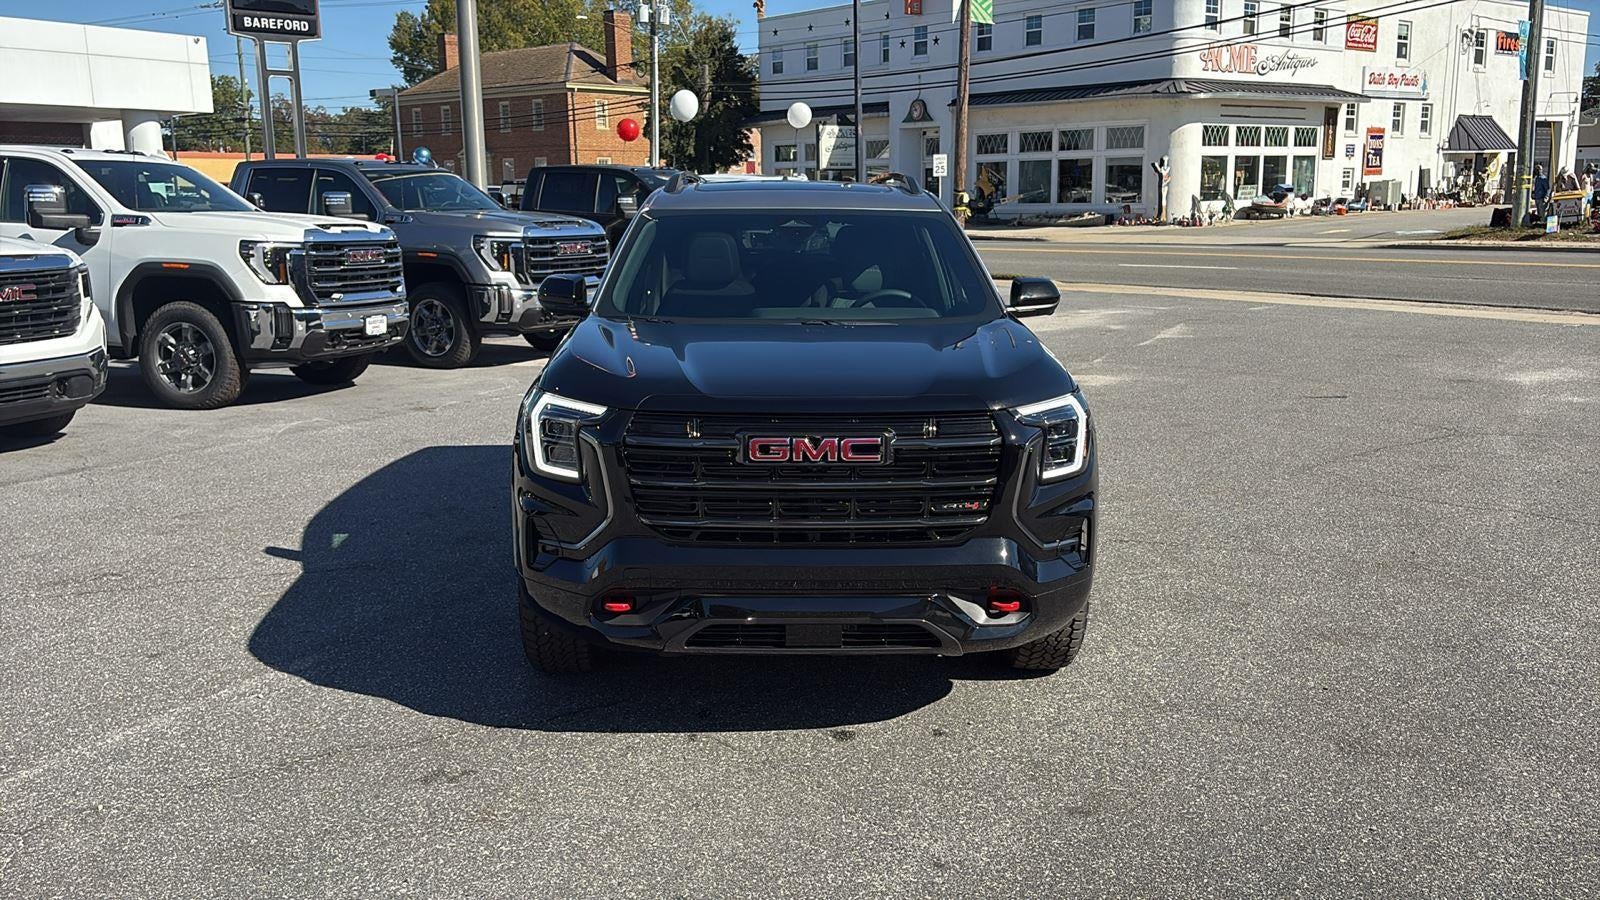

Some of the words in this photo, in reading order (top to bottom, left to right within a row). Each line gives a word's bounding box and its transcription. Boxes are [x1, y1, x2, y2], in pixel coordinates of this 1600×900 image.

[243, 16, 309, 32] BAREFORD
[1199, 43, 1258, 75] ACME
[1368, 71, 1386, 86] Dutch
[1388, 73, 1399, 89] Boy
[1400, 73, 1420, 87] Paints
[1368, 153, 1381, 167] TEA
[935, 165, 946, 174] 25
[749, 436, 883, 462] GMC
